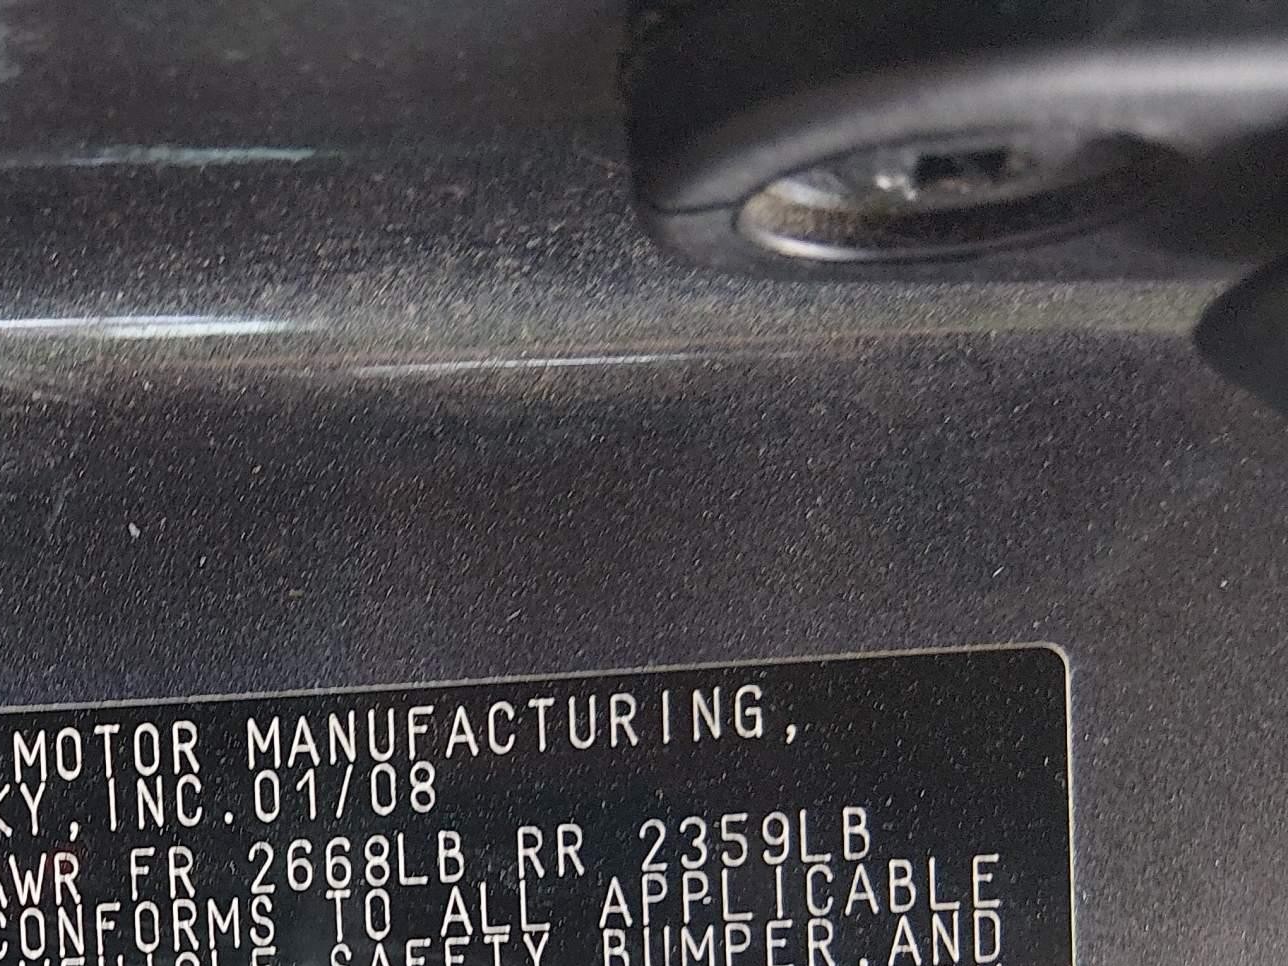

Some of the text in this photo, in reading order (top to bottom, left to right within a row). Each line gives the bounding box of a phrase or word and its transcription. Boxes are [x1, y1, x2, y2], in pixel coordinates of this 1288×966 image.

[13, 719, 201, 784] MOTOR
[247, 684, 798, 769] MANUFACTURING,
[129, 844, 196, 901] FR
[248, 829, 466, 895] 2668LB
[516, 822, 586, 880] RR
[638, 805, 872, 873] 2359LB
[325, 887, 392, 943] TO
[440, 879, 552, 937] ALL
[598, 853, 1002, 929] APPLICABLE
